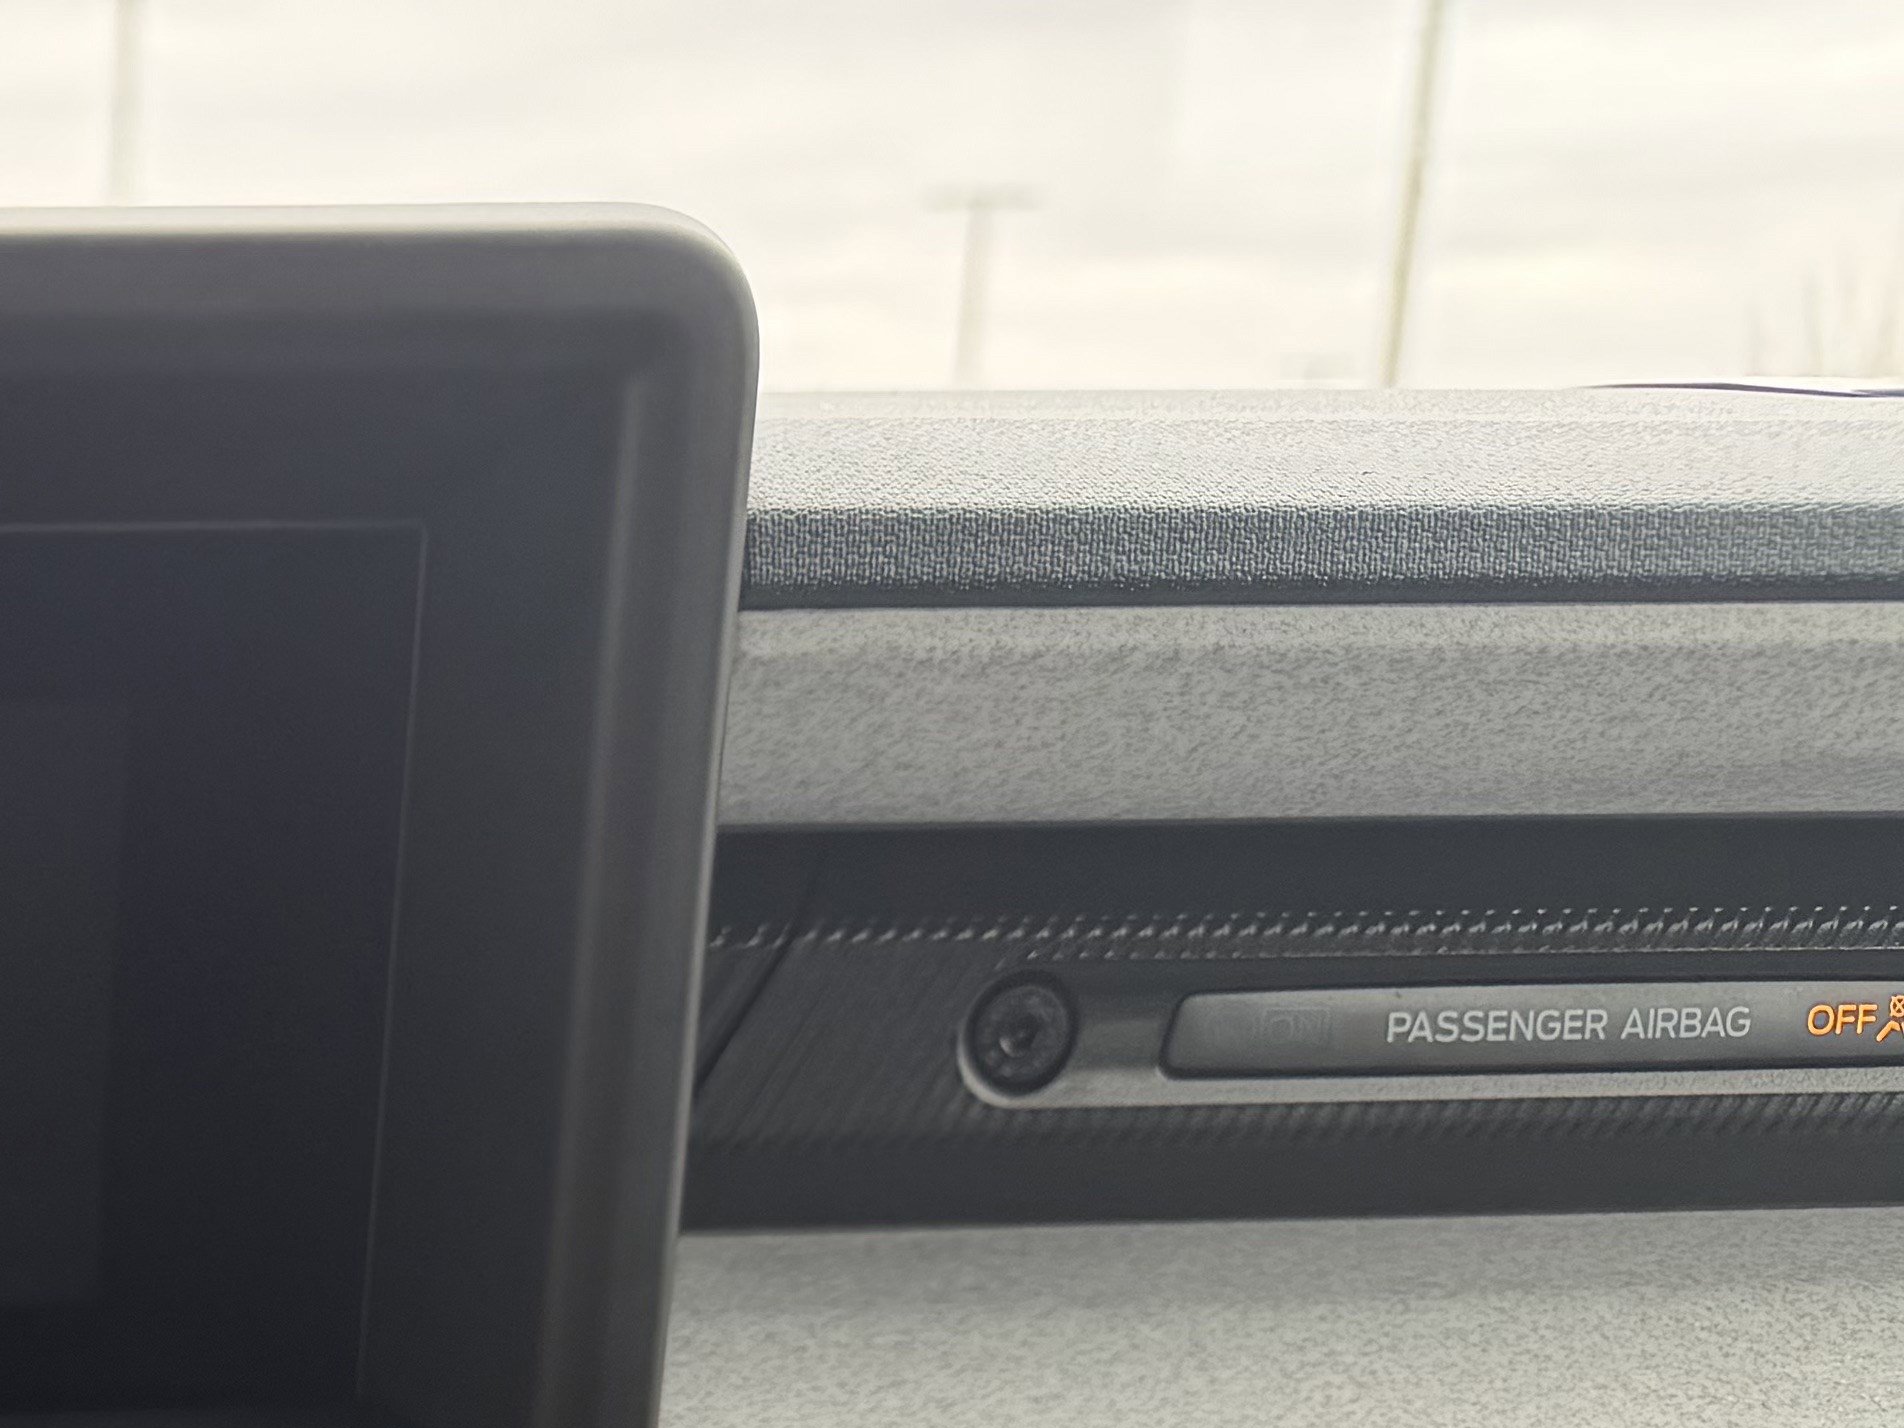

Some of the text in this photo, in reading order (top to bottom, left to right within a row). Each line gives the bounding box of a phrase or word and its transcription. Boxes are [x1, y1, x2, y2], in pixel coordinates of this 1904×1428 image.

[1387, 1006, 1752, 1043] PASSENGER AIRBAG
[1806, 1003, 1879, 1036] OFF
